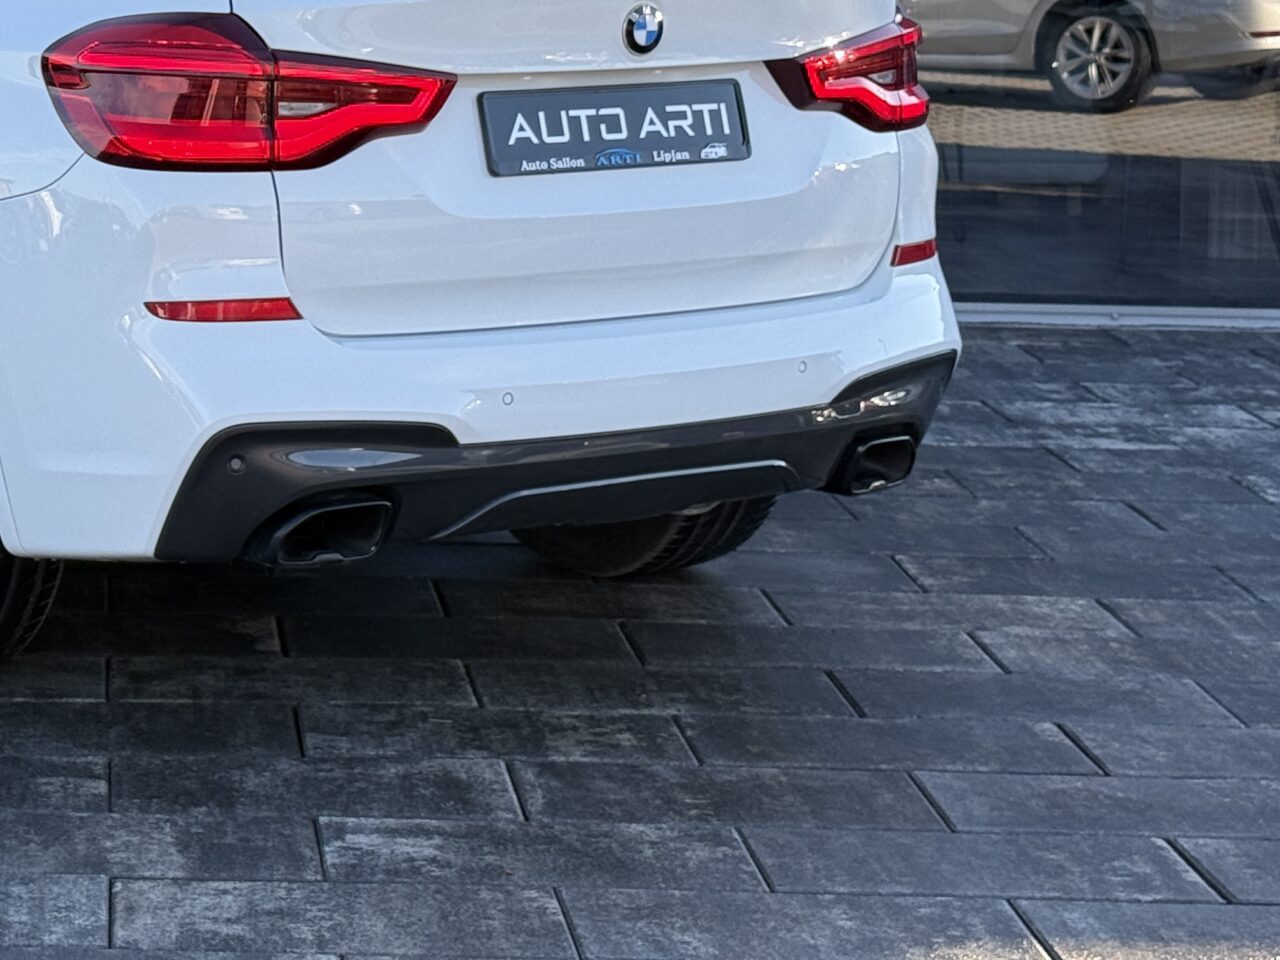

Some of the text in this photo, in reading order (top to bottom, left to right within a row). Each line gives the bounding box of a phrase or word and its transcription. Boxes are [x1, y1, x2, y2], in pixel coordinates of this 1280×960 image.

[507, 102, 731, 146] AUTO ARTI
[595, 153, 641, 167] ARTI
[653, 149, 690, 163] Lipjan
[520, 159, 549, 172] Auto
